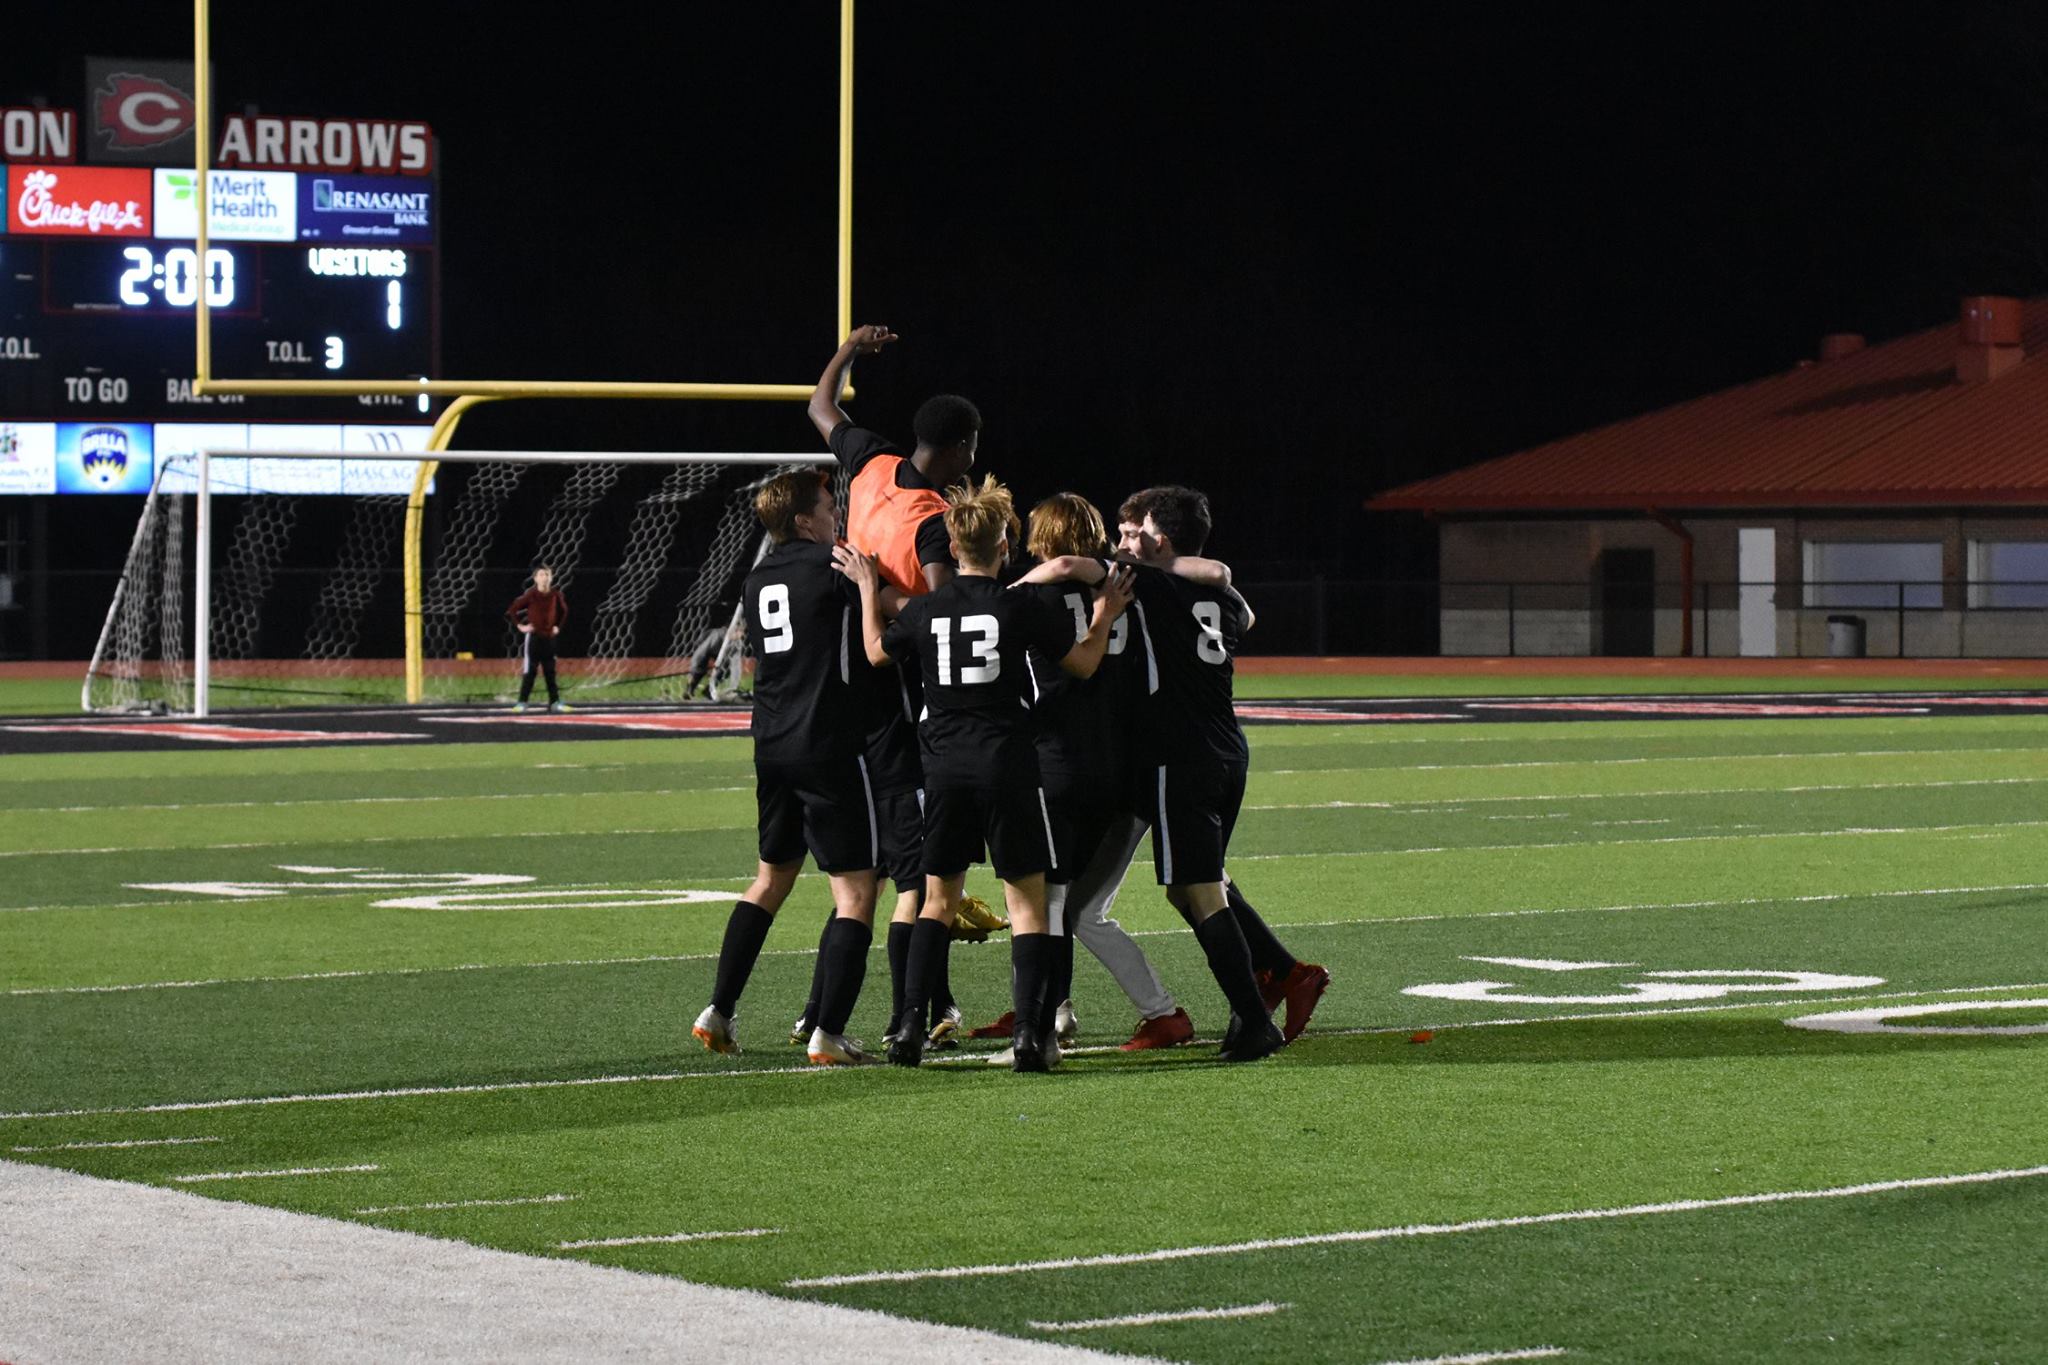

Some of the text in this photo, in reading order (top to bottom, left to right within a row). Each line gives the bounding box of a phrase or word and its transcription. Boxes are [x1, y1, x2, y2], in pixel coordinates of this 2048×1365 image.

[0, 110, 70, 157] ON
[218, 117, 427, 169] ARROWS
[212, 176, 267, 197] Merit
[333, 192, 429, 210] RENASANT
[212, 196, 278, 218] Health
[394, 212, 430, 225] BANK
[120, 247, 234, 307] 2:00
[308, 248, 407, 277] VISITORS
[387, 279, 401, 330] 1
[267, 341, 312, 363] T.O.L.
[325, 336, 343, 369] 3
[65, 377, 128, 402] TO GO
[759, 583, 793, 653] 9
[1192, 601, 1227, 665] 8
[931, 614, 1000, 686] 13
